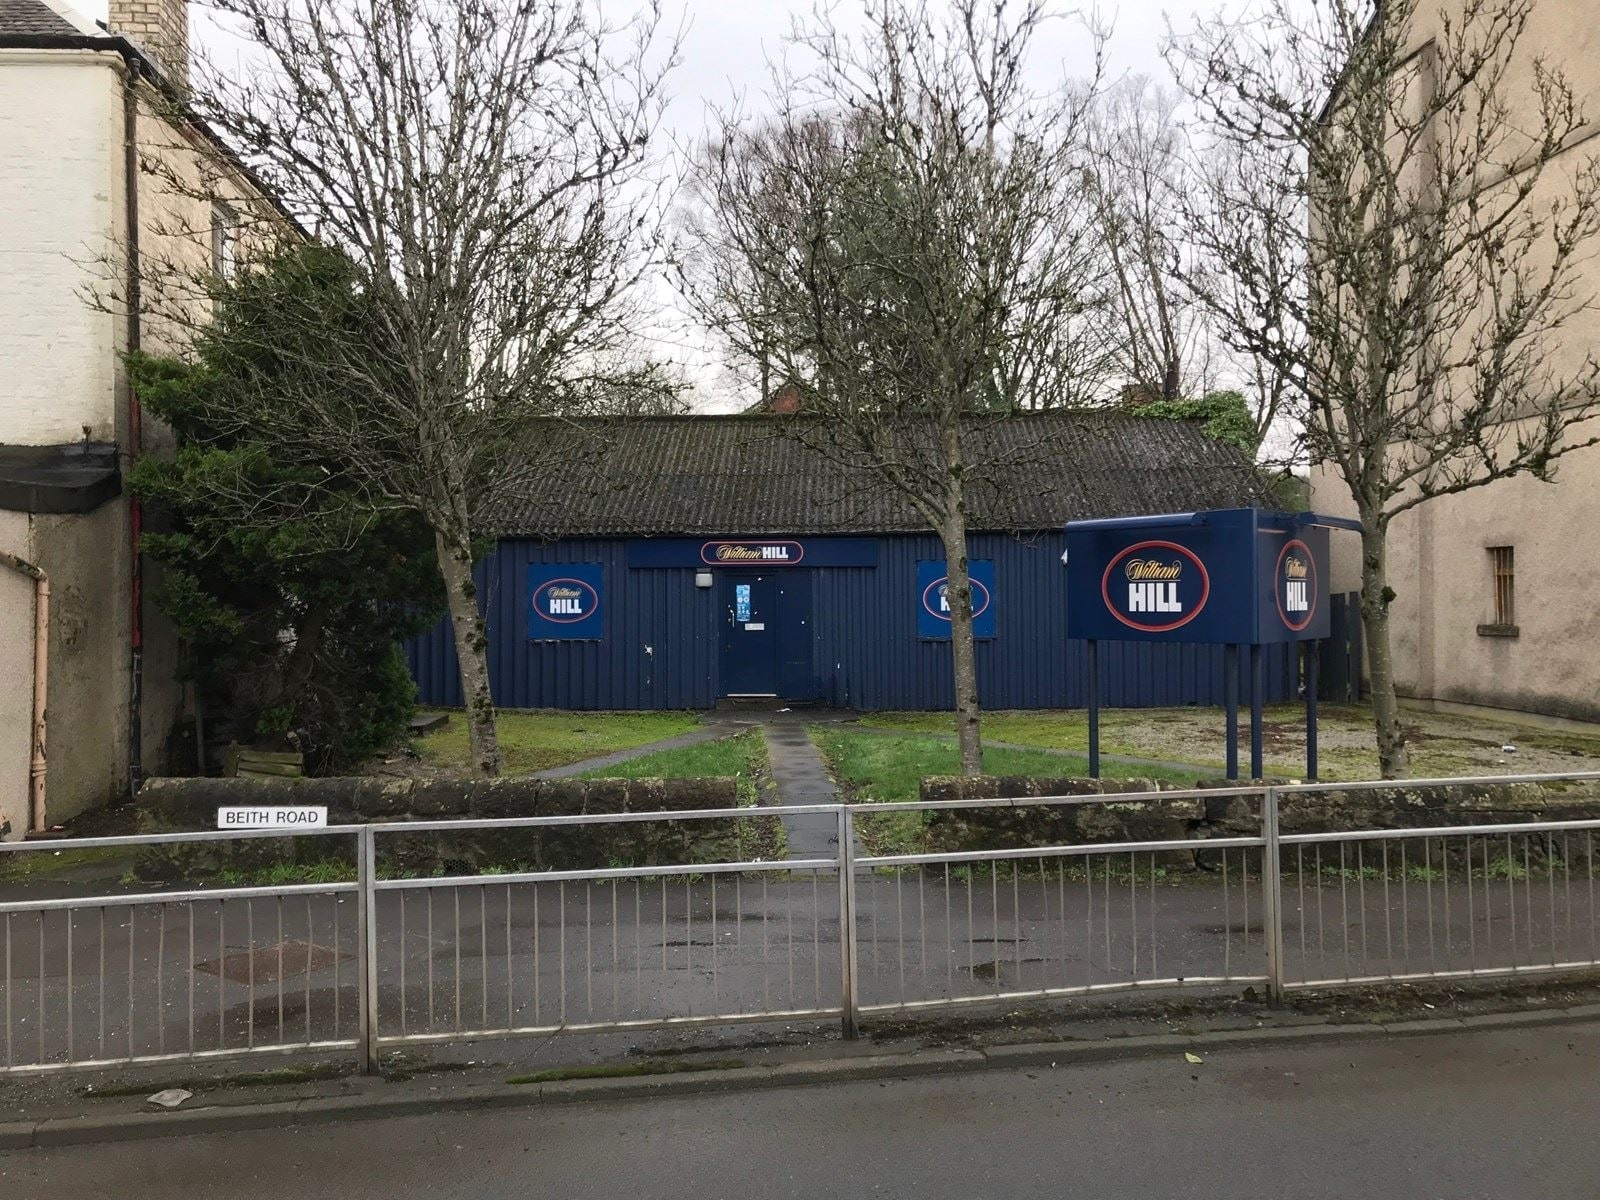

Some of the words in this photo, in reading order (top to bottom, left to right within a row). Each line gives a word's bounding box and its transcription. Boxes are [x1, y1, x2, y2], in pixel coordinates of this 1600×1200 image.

[762, 546, 789, 559] HILL
[1125, 559, 1181, 582] William
[549, 599, 582, 614] HILL
[1129, 582, 1182, 612] HILL
[1286, 582, 1308, 612] HILL
[226, 812, 269, 823] BEITH
[276, 811, 318, 823] ROAD
